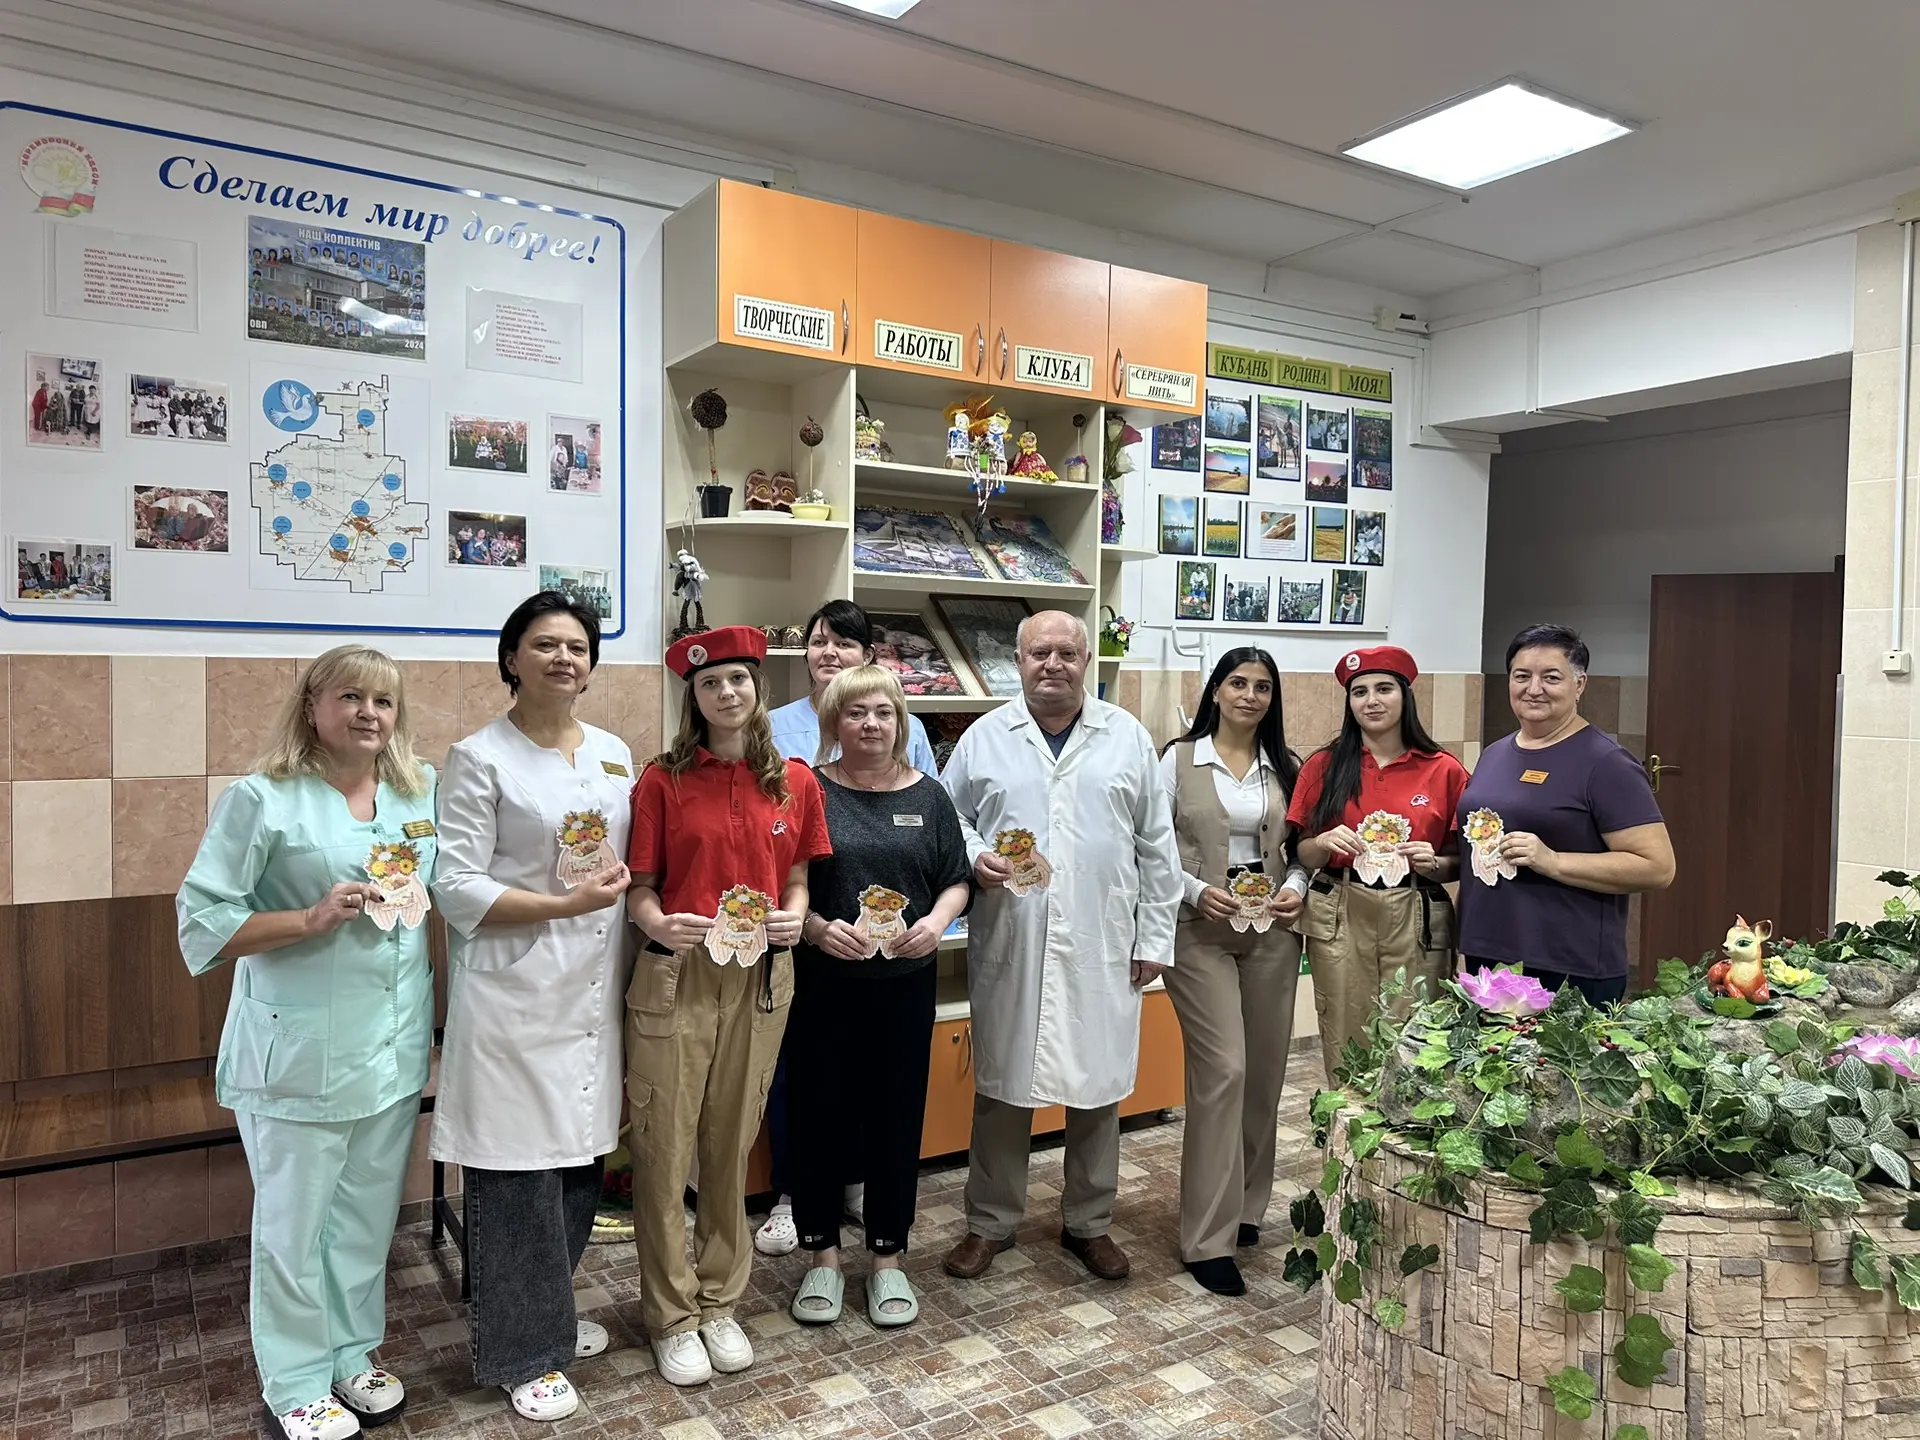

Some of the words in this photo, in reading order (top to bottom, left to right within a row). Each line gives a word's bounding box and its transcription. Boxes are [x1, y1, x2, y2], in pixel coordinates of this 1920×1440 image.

[159, 156, 349, 218] Сделаем
[365, 203, 450, 243] мир
[461, 210, 601, 264] добрее!
[298, 228, 322, 241] НАШ
[324, 232, 381, 251] КОЛЛЕКТИВ
[250, 319, 267, 329] ОВП
[404, 340, 424, 350] 2024
[743, 305, 825, 341] ТВОРЧЕСКИЕ
[884, 329, 953, 363] РАБОТЫ
[1027, 354, 1082, 383] КЛУБА
[1131, 369, 1191, 387] «СЕРЕБРЯНАЯ
[1220, 355, 1268, 378] КУБАНЬ
[1282, 364, 1327, 386] РОДИНА
[1347, 374, 1383, 394] МОЯ!
[1148, 385, 1175, 399] НИТЬ»
